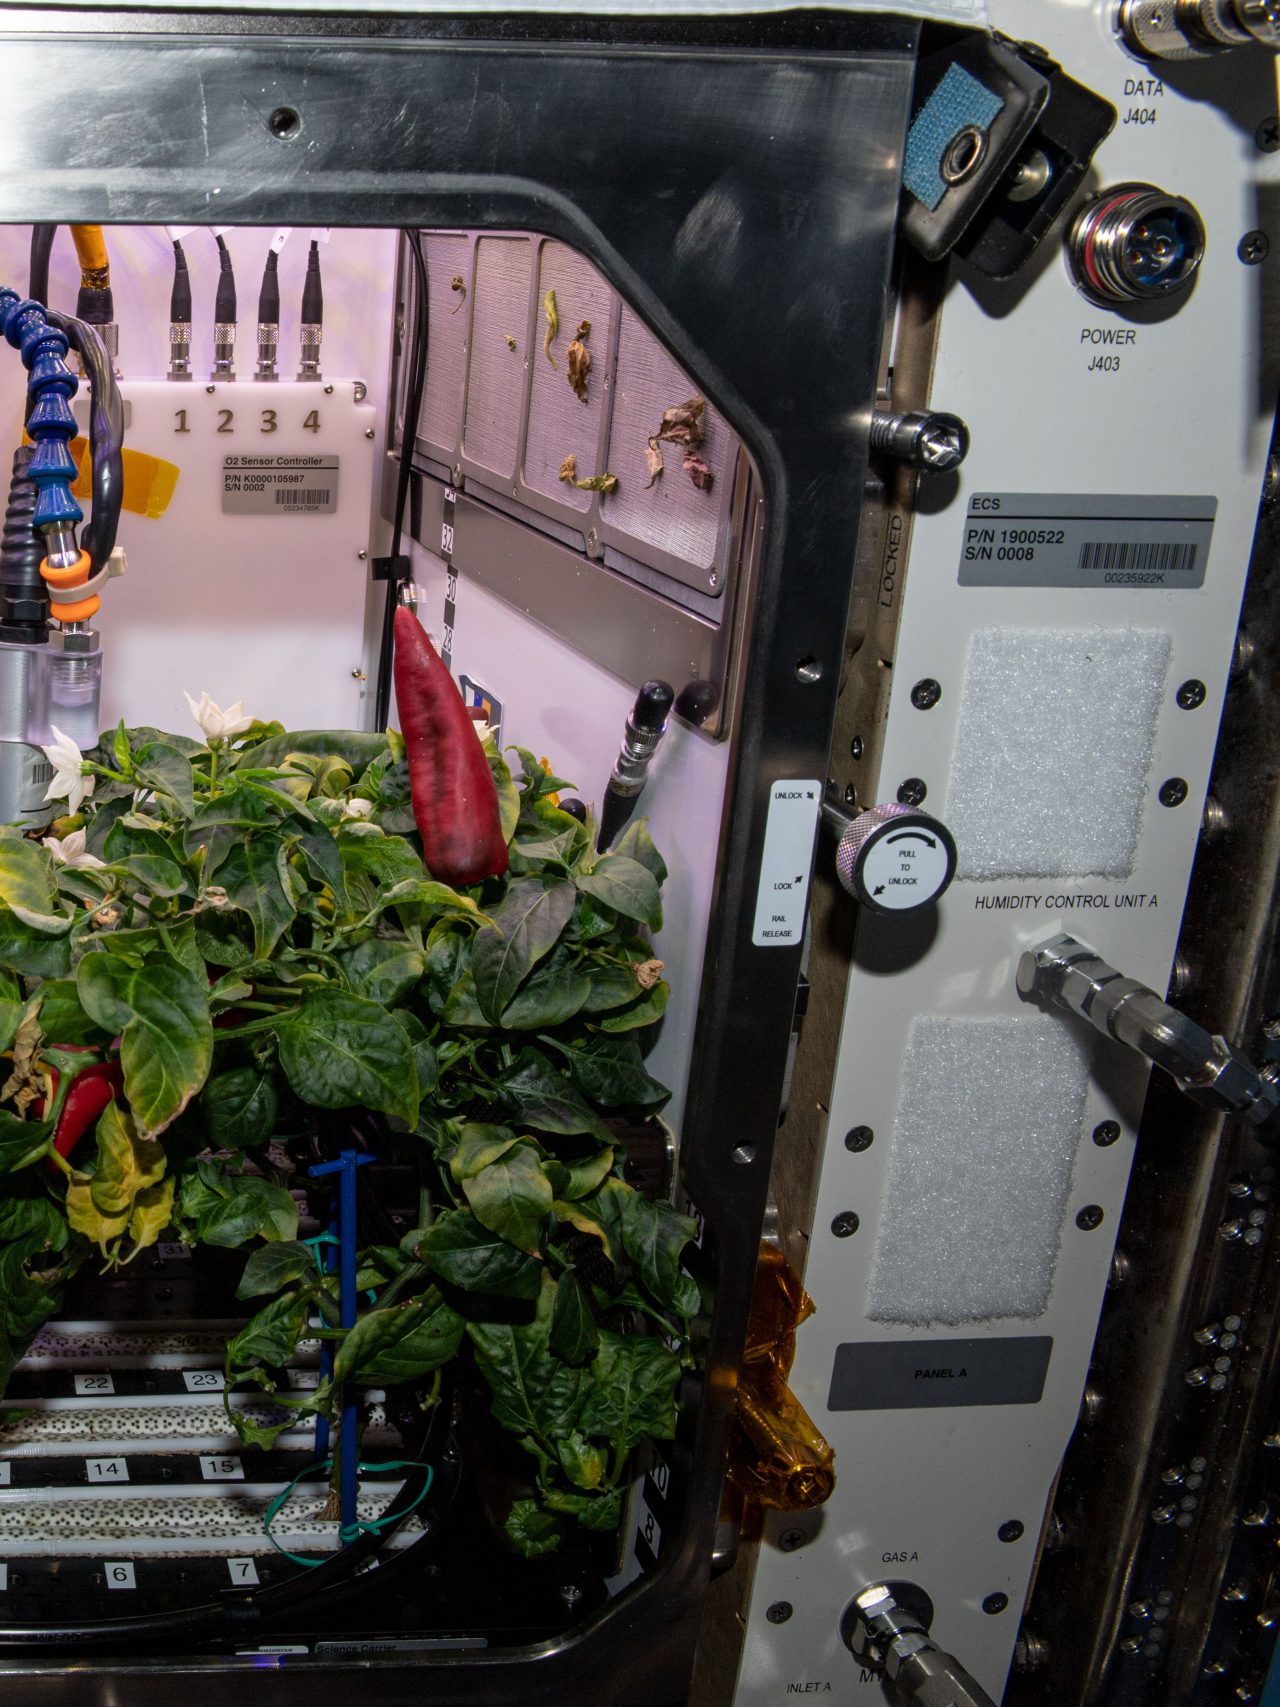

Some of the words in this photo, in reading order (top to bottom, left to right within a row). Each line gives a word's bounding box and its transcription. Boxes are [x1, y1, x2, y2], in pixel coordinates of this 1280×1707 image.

[1123, 80, 1164, 96] DATA
[1123, 109, 1156, 125] J404
[1080, 329, 1136, 345] POWER
[1088, 355, 1120, 371] J403
[174, 409, 191, 433] 1
[216, 409, 234, 433] 2
[260, 409, 278, 433] 3
[302, 410, 321, 434] 4
[225, 457, 238, 466] O2
[241, 457, 274, 466] Sensor
[276, 457, 323, 466] Controller
[225, 475, 241, 484] P/N
[243, 475, 304, 483] K0000105987
[225, 484, 241, 492] S/N
[243, 484, 265, 492] 0002
[972, 498, 1000, 510] ECS
[442, 525, 453, 552] 32
[967, 530, 995, 544] P/N
[1001, 530, 1065, 544] 1900522
[964, 547, 992, 561] S/N
[997, 547, 1034, 561] 0008
[880, 515, 902, 608] LOCKED
[1104, 572, 1165, 584] 00235922K
[446, 575, 457, 602] 30
[442, 625, 453, 653] 28
[775, 792, 803, 800] UNLOCK
[898, 850, 916, 858] PULL
[901, 863, 911, 871] TO
[774, 882, 793, 890] LOCK
[975, 895, 1042, 909] HUMIDITY
[1045, 895, 1110, 908] CONTROL
[1114, 894, 1147, 908] UNIT
[1148, 894, 1158, 908] A
[771, 915, 787, 923] RAIL
[762, 930, 792, 938] RELEASE
[191, 1374, 218, 1386] 23
[914, 1368, 955, 1379] PANEL
[958, 1368, 968, 1378] A
[84, 1376, 109, 1390] 22
[94, 1462, 119, 1476] 14
[208, 1459, 234, 1474] 15
[644, 1512, 655, 1545] 8
[881, 1552, 907, 1563] GAS
[909, 1551, 919, 1562] A
[113, 1567, 128, 1583] 6
[236, 1562, 250, 1578] 7
[318, 1645, 359, 1654] Science
[361, 1643, 397, 1653] Carrier
[786, 1682, 821, 1694] INLET
[823, 1682, 832, 1692] A
